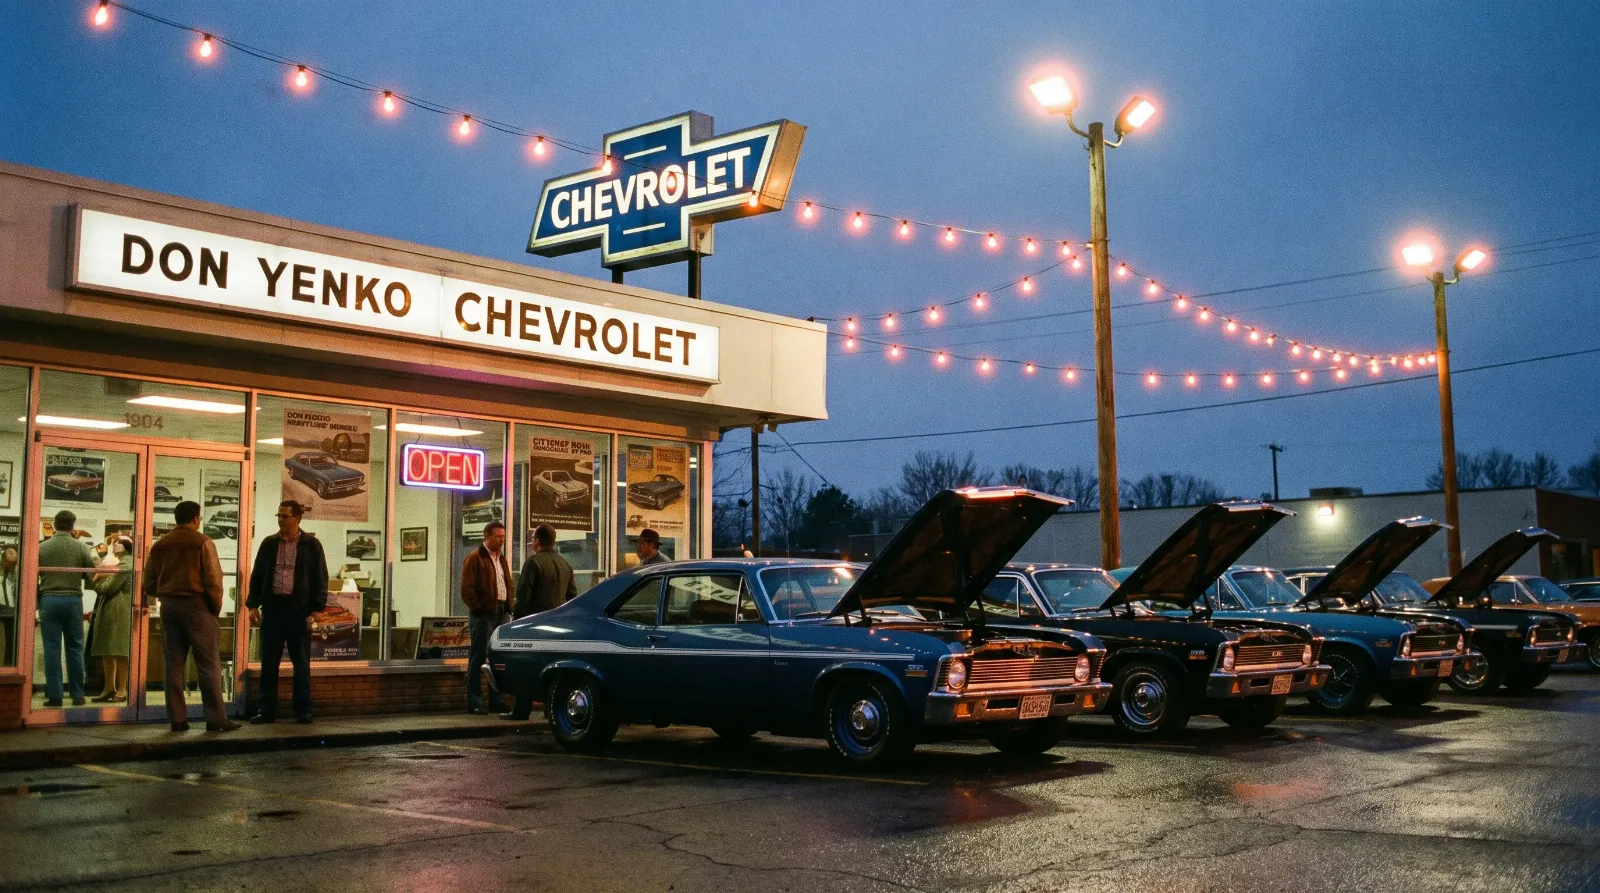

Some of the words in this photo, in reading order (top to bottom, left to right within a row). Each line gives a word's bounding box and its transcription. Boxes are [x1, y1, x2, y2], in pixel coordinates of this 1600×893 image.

[551, 146, 751, 229] CHEVROLET
[122, 233, 229, 290] DON
[257, 257, 412, 318] YENKO
[454, 291, 696, 366] CHEVROLET
[124, 412, 163, 431] 1904
[408, 449, 480, 485] OPEN
